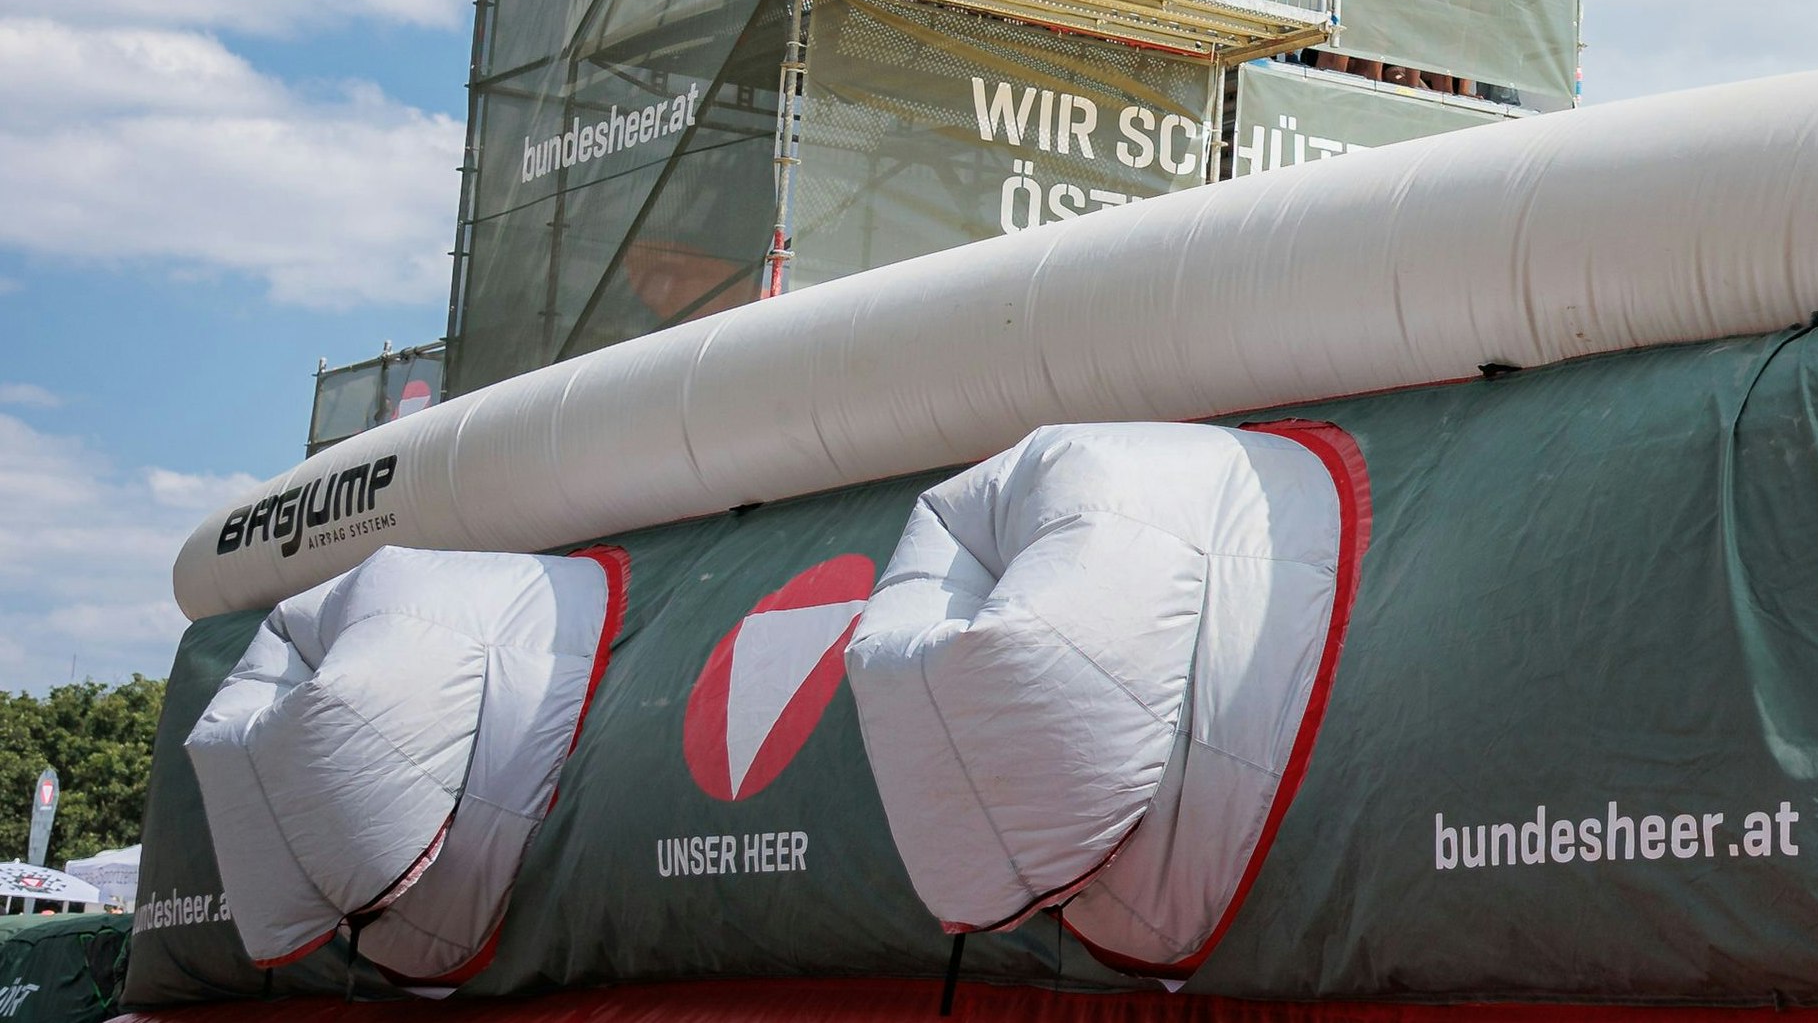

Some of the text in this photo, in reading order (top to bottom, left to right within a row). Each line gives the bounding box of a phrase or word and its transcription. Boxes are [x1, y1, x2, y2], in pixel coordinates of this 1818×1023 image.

[521, 82, 699, 184] bundesheer.at
[972, 77, 1098, 159] WIR
[216, 454, 398, 558] BAGJUMP
[308, 512, 398, 551] AIRBAG SYSTEMS
[657, 830, 809, 877] UNSER HEER
[1435, 800, 1800, 870] bundesheer.at
